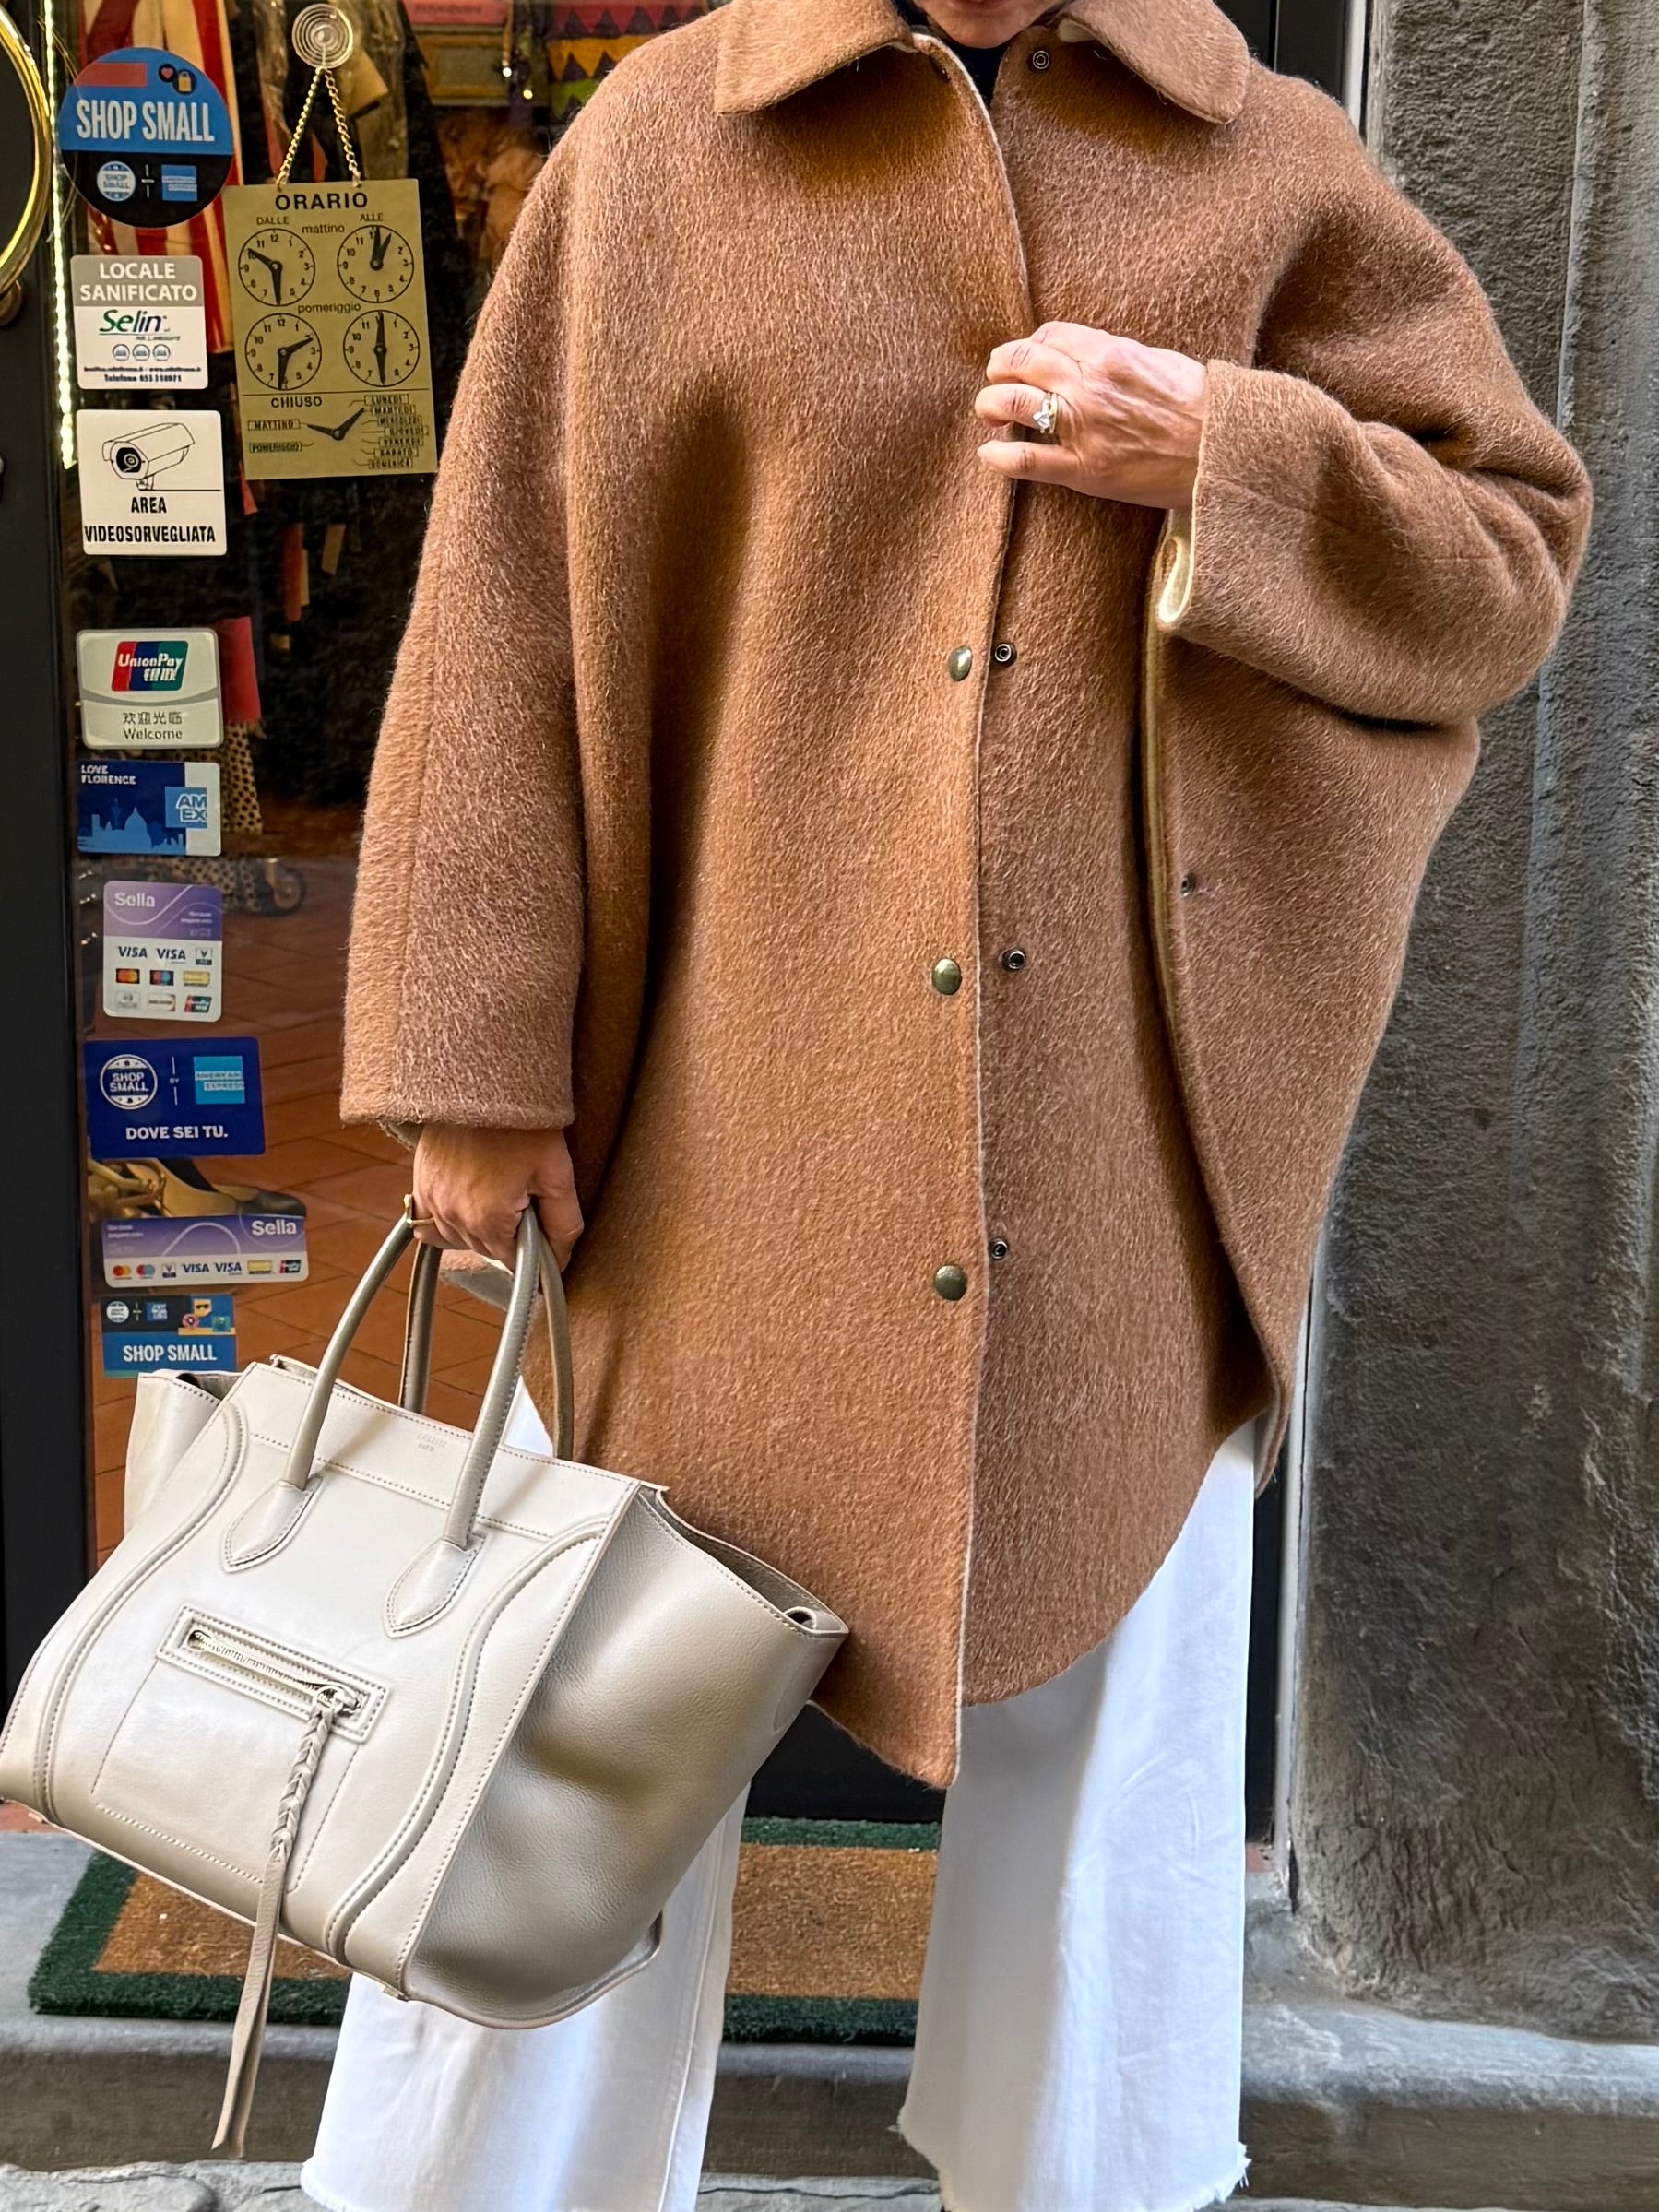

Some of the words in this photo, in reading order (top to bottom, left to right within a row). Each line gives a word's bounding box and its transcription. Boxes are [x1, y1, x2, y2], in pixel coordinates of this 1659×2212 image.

[77, 99, 137, 139] SHOP
[141, 101, 215, 142] SMALL
[275, 192, 368, 211] ORARIO
[256, 216, 290, 225] DALLE
[360, 213, 384, 222] ALLE
[302, 223, 345, 234] mattino
[99, 263, 176, 279] LOCALE
[80, 284, 197, 302] SANIFICATO
[298, 302, 361, 314] pomeriggio
[99, 309, 163, 333] Selin
[271, 396, 323, 408] CHIUSO
[254, 420, 294, 431] MATTINO
[131, 497, 167, 514] AREA
[84, 526, 216, 542] VIDEOSORVEGLIATA
[118, 653, 184, 671] UnionPay
[122, 711, 183, 725] 欢迎光临
[123, 728, 183, 739] Welcome
[81, 764, 109, 775] LOVE
[81, 775, 136, 785] FLORENCE
[176, 794, 207, 809] AM
[114, 892, 155, 907] Sella
[118, 946, 148, 958] VISA
[156, 948, 186, 960] VISA
[113, 1072, 144, 1082] SHOP
[110, 1082, 148, 1093] SMALL
[125, 1126, 170, 1140] DOVE
[173, 1126, 199, 1139] SEI
[202, 1125, 228, 1138] TU.
[252, 1219, 297, 1236] Sella
[182, 1263, 210, 1273] VISA
[214, 1262, 242, 1272] VISA
[123, 1345, 165, 1362] SHOP
[168, 1344, 217, 1362] SMALL
